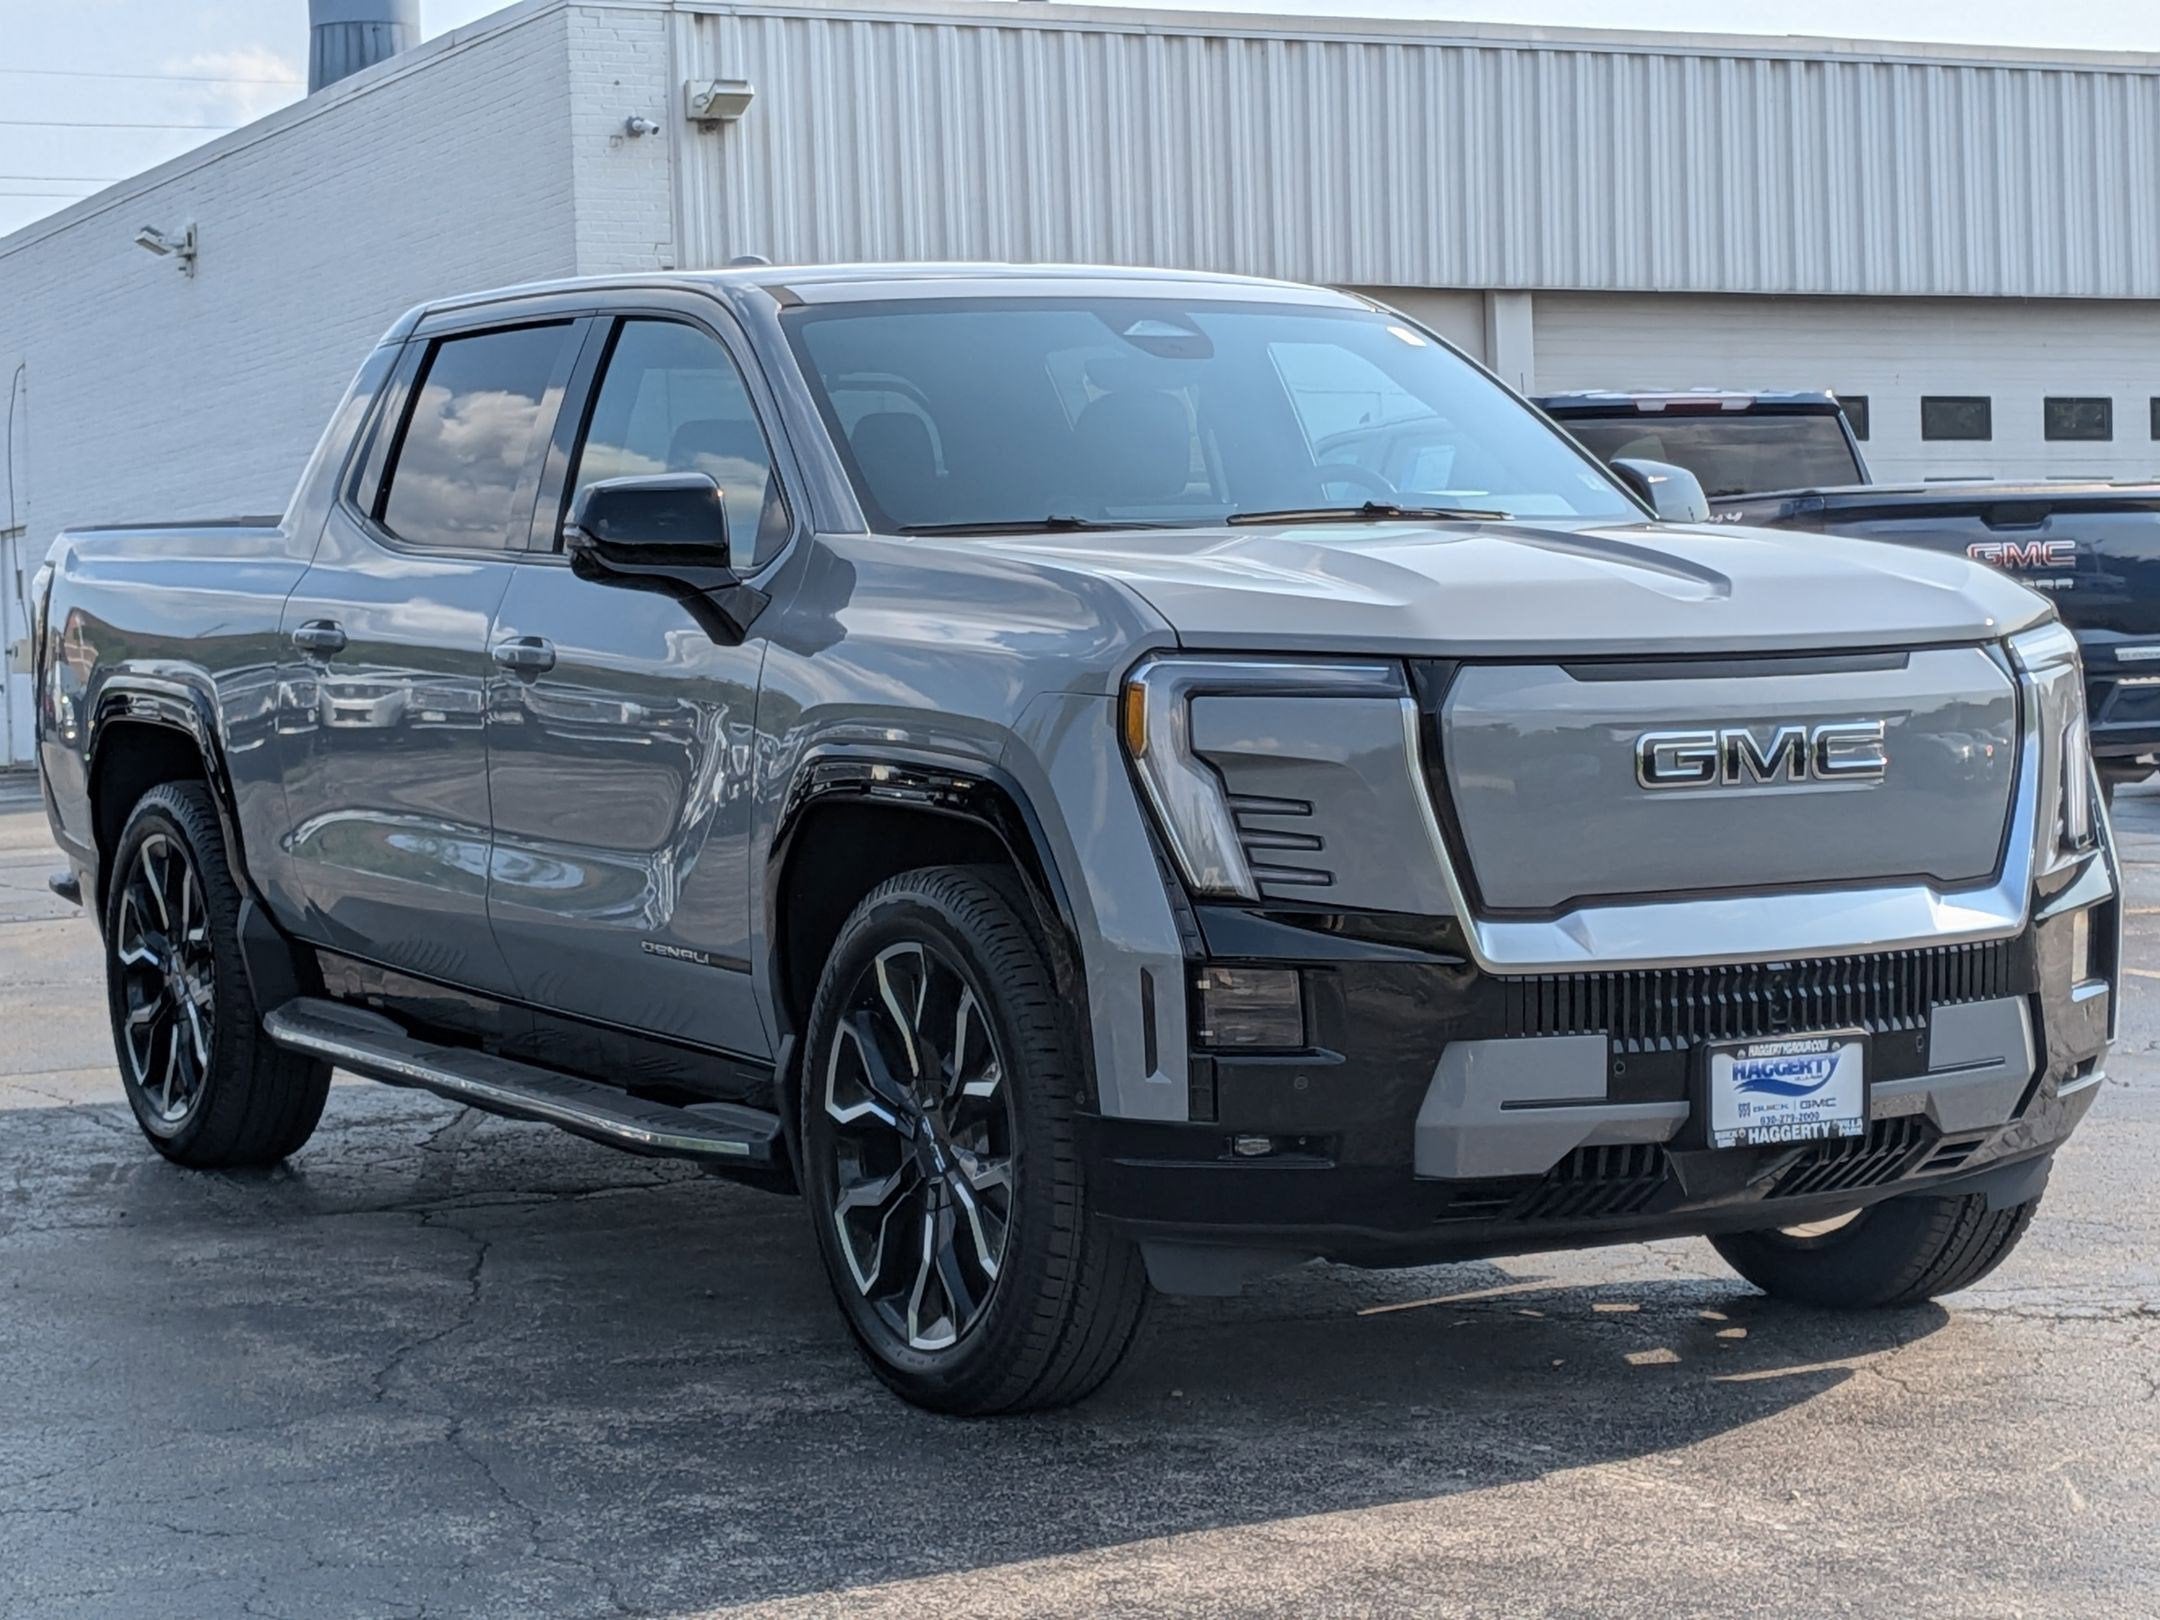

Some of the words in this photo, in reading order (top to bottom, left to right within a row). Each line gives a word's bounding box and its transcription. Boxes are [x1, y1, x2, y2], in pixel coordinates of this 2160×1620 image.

[1966, 540, 2076, 569] GMC
[1635, 720, 1887, 789] GMC
[641, 941, 709, 965] DENALI
[1732, 1053, 1842, 1081] HAGGERTY
[1753, 1103, 1789, 1113] BUICK
[1800, 1097, 1837, 1110] GMC
[1748, 1120, 1831, 1144] HAGGERTY
